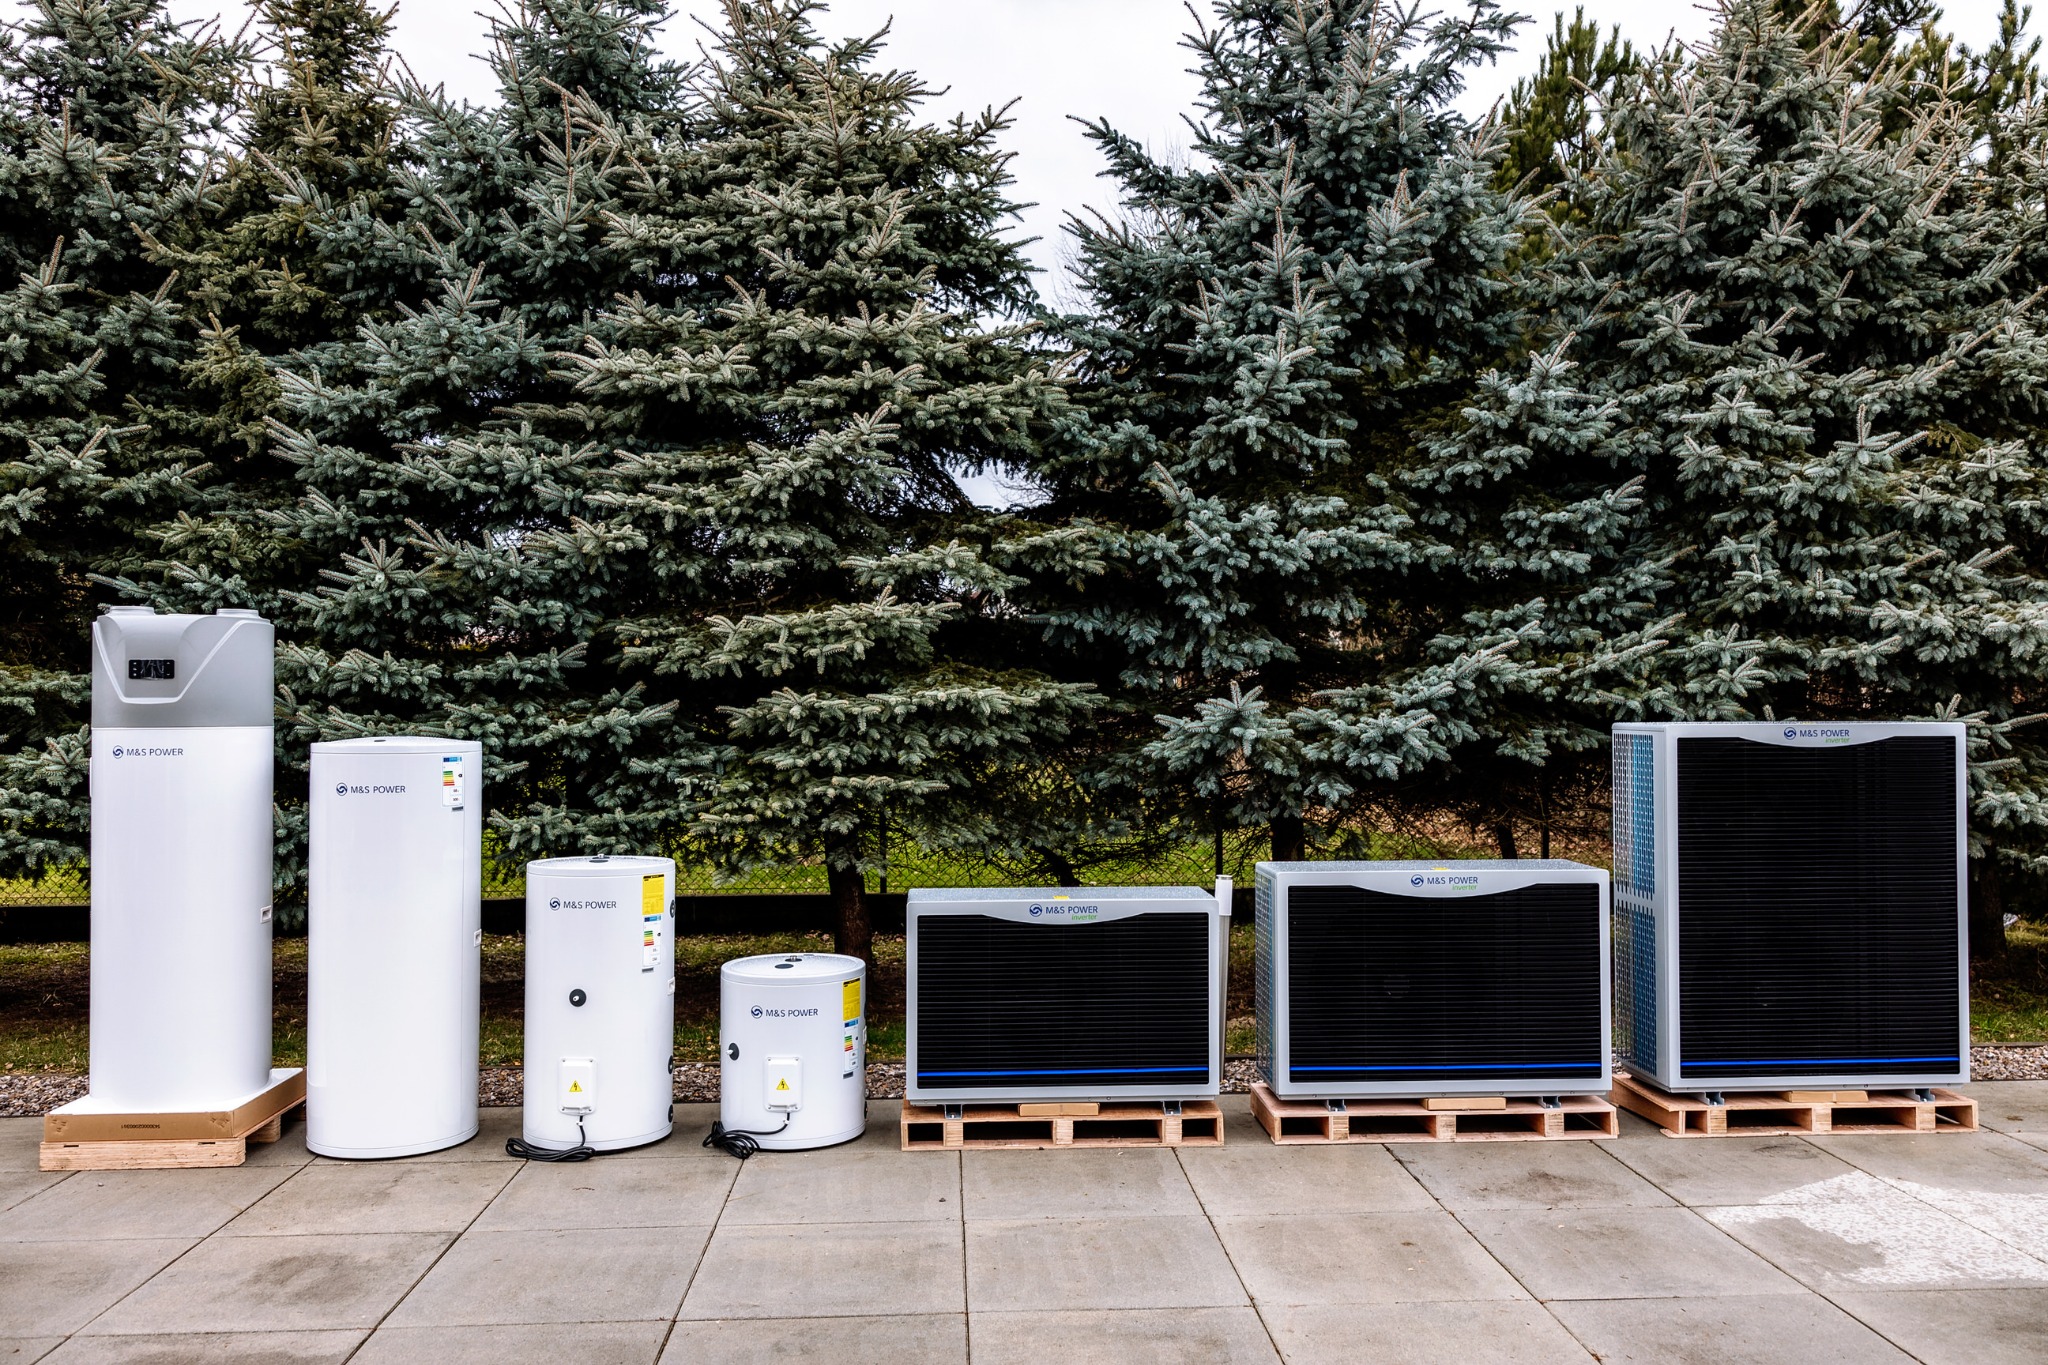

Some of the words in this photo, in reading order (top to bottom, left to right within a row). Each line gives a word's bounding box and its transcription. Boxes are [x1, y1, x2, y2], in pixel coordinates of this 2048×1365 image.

[1799, 729, 1818, 738] M&S
[1820, 729, 1850, 738] POWER
[126, 748, 147, 757] M&S
[149, 748, 184, 757] POWER
[350, 785, 370, 794] M&S
[373, 785, 406, 794] POWER
[1427, 876, 1446, 885] M&S
[1448, 876, 1478, 885] POWER
[563, 900, 583, 910] M&S
[585, 900, 617, 910] POWER
[1045, 906, 1065, 915] M&S
[1067, 905, 1098, 914] POWER
[765, 1009, 786, 1018] M&S
[787, 1008, 819, 1018] POWER
